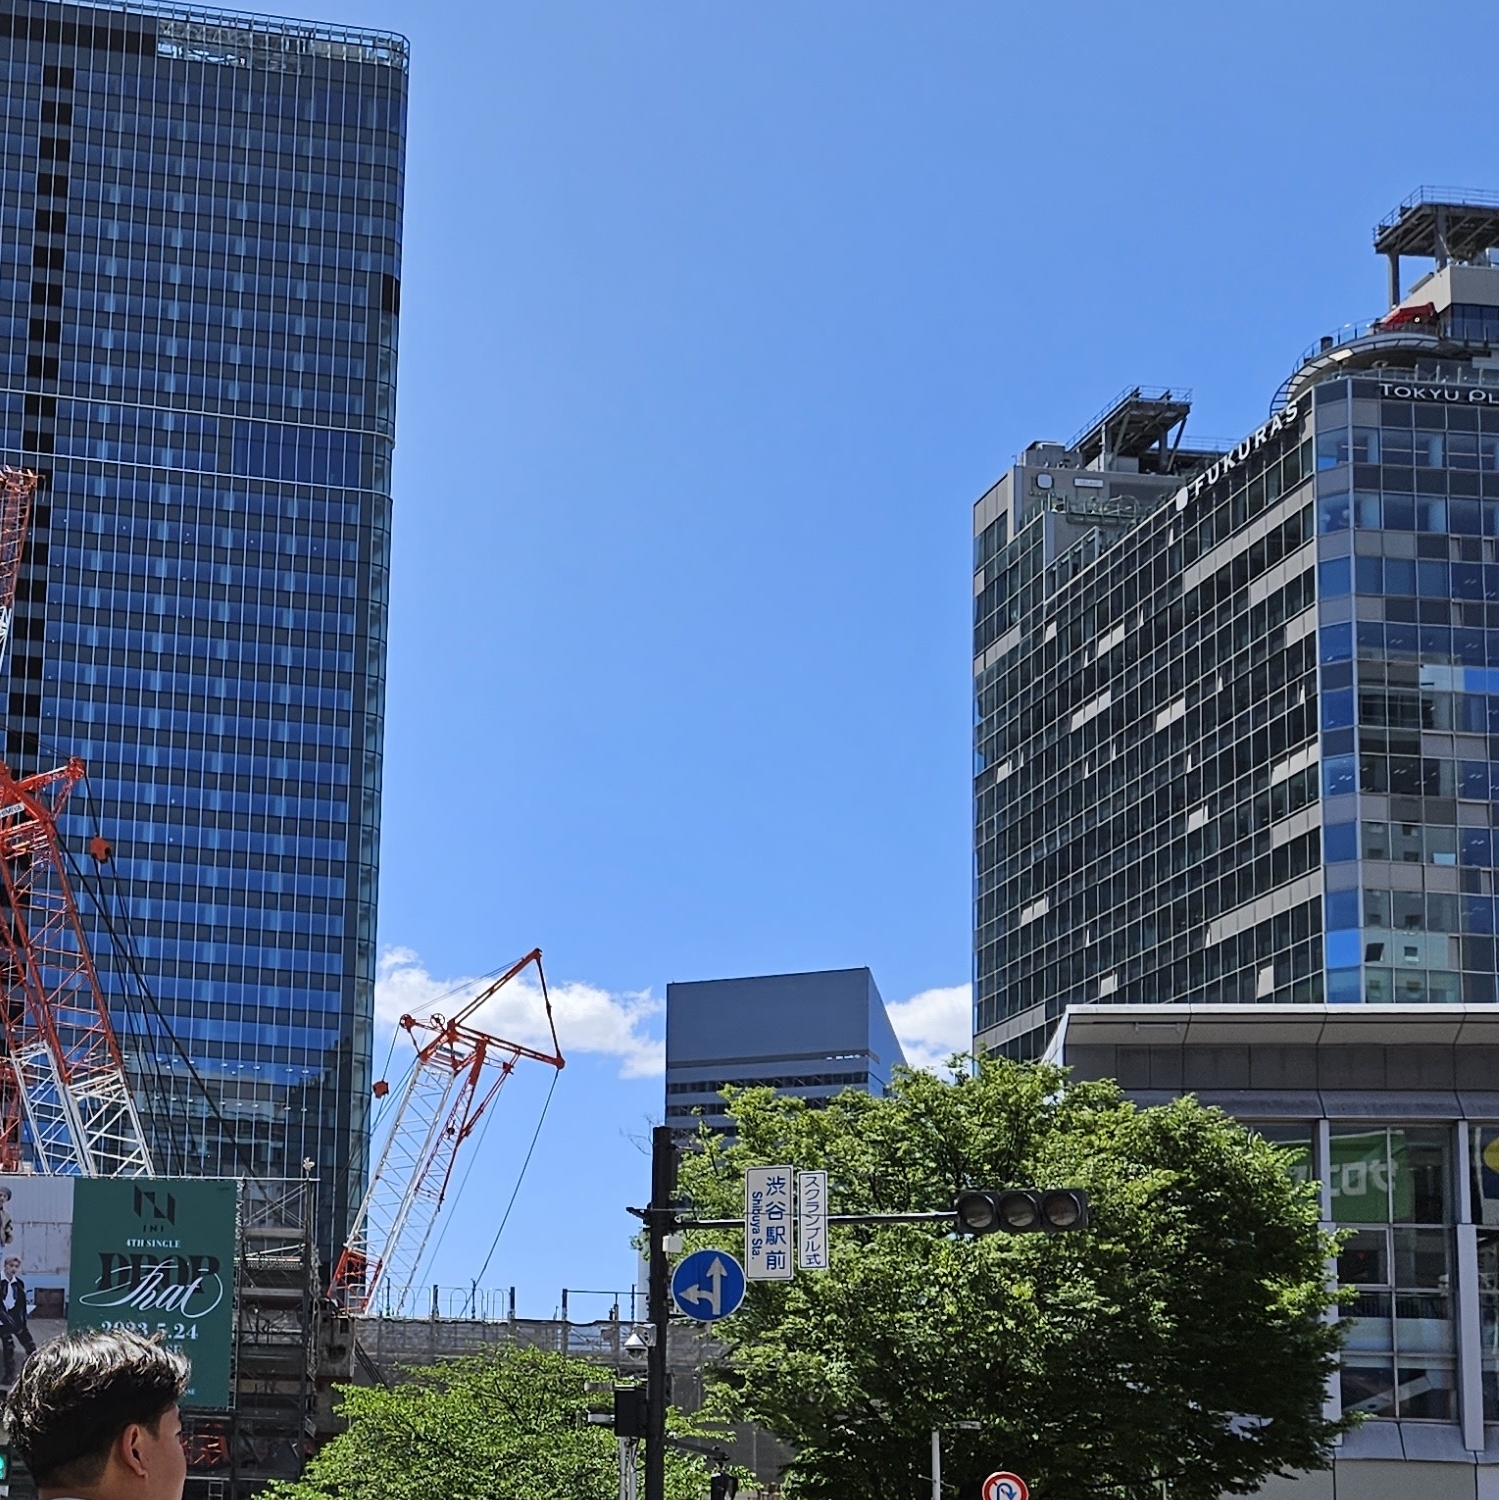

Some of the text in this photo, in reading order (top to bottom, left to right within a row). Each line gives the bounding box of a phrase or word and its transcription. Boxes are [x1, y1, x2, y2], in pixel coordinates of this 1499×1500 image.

[1379, 383, 1460, 401] TOKYU
[1194, 400, 1299, 497] FUKURAS
[126, 1238, 182, 1249] 4TH SINGLE
[750, 1191, 763, 1260] Shibuya Sta.
[765, 1175, 787, 1271] 渋谷駅前
[804, 1176, 822, 1266] スクランブル式
[79, 1259, 224, 1319] That
[101, 1320, 199, 1340] 20235.24
